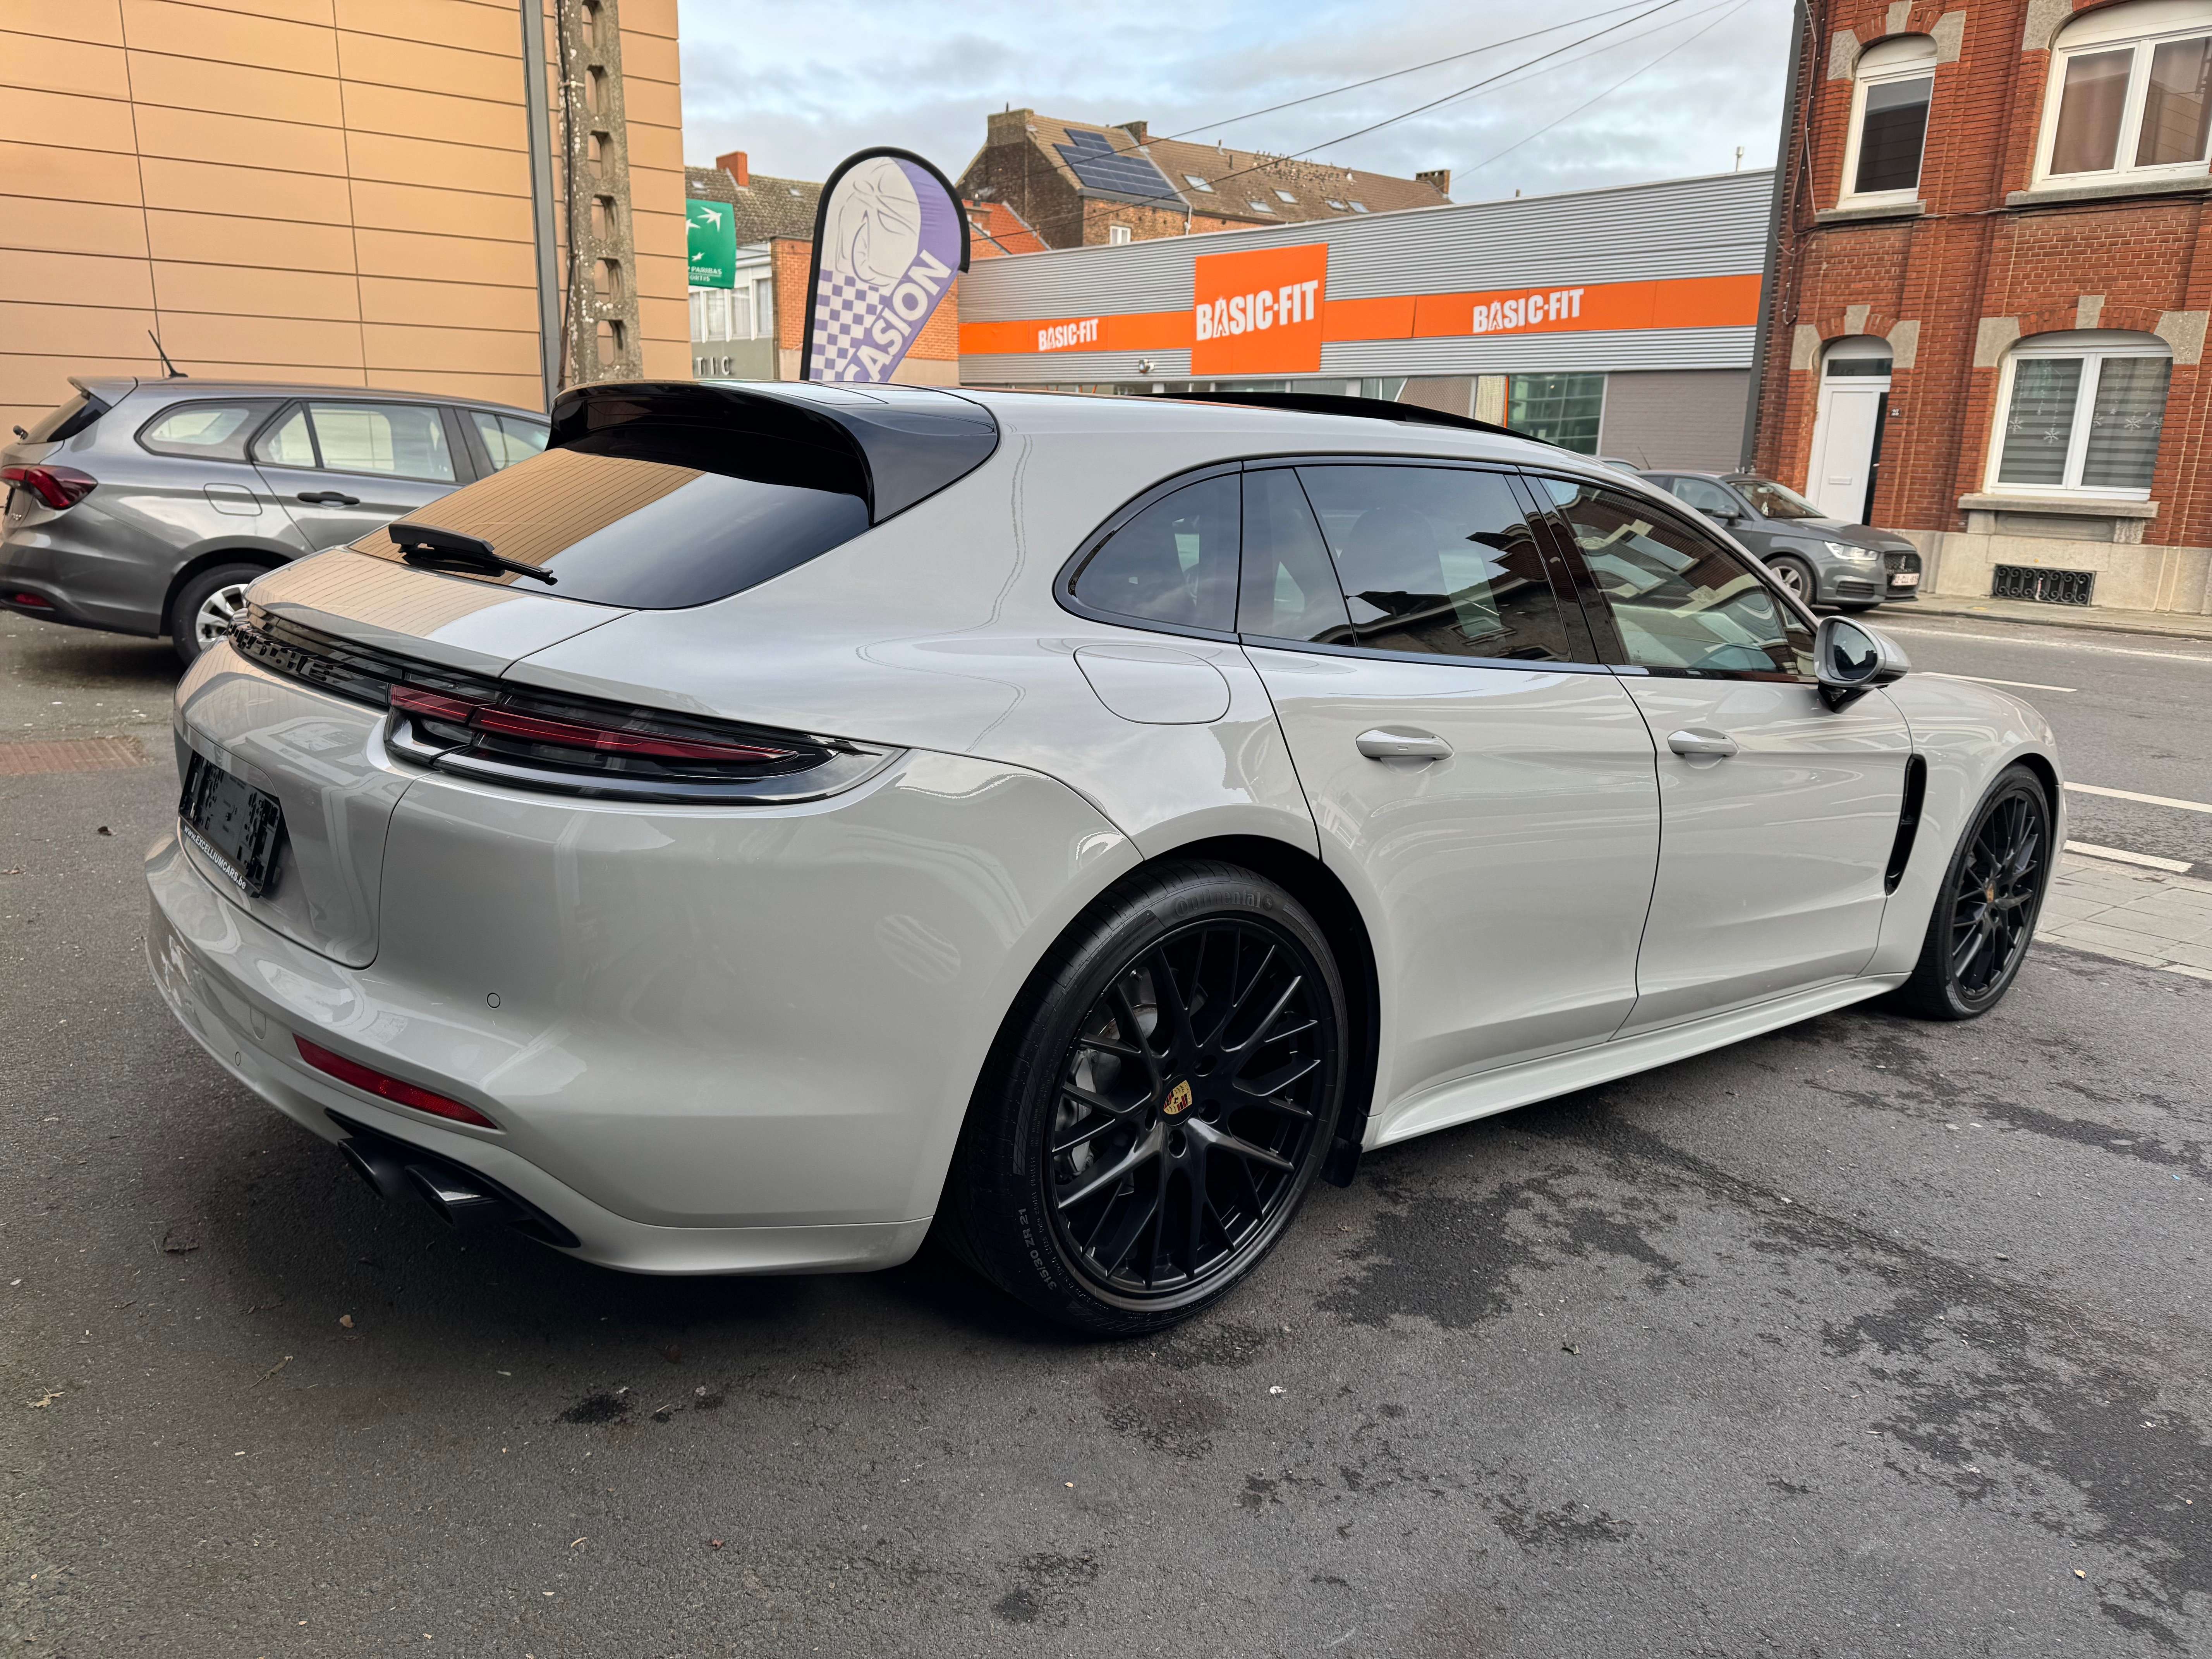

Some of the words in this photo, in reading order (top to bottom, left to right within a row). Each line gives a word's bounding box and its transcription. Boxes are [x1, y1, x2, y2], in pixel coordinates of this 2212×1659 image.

[691, 266, 722, 275] PARIBAS
[1196, 280, 1318, 341] BASIC-FIT
[1473, 288, 1584, 333] BASIC-FIT
[1038, 318, 1098, 351] BASIC-FIT
[696, 356, 730, 375] TIC
[184, 825, 246, 889] www.EXCELLIUMCARS.be
[1018, 1208, 1029, 1225] 21
[1022, 1228, 1035, 1247] ZR
[1030, 1250, 1057, 1290] 315/30
